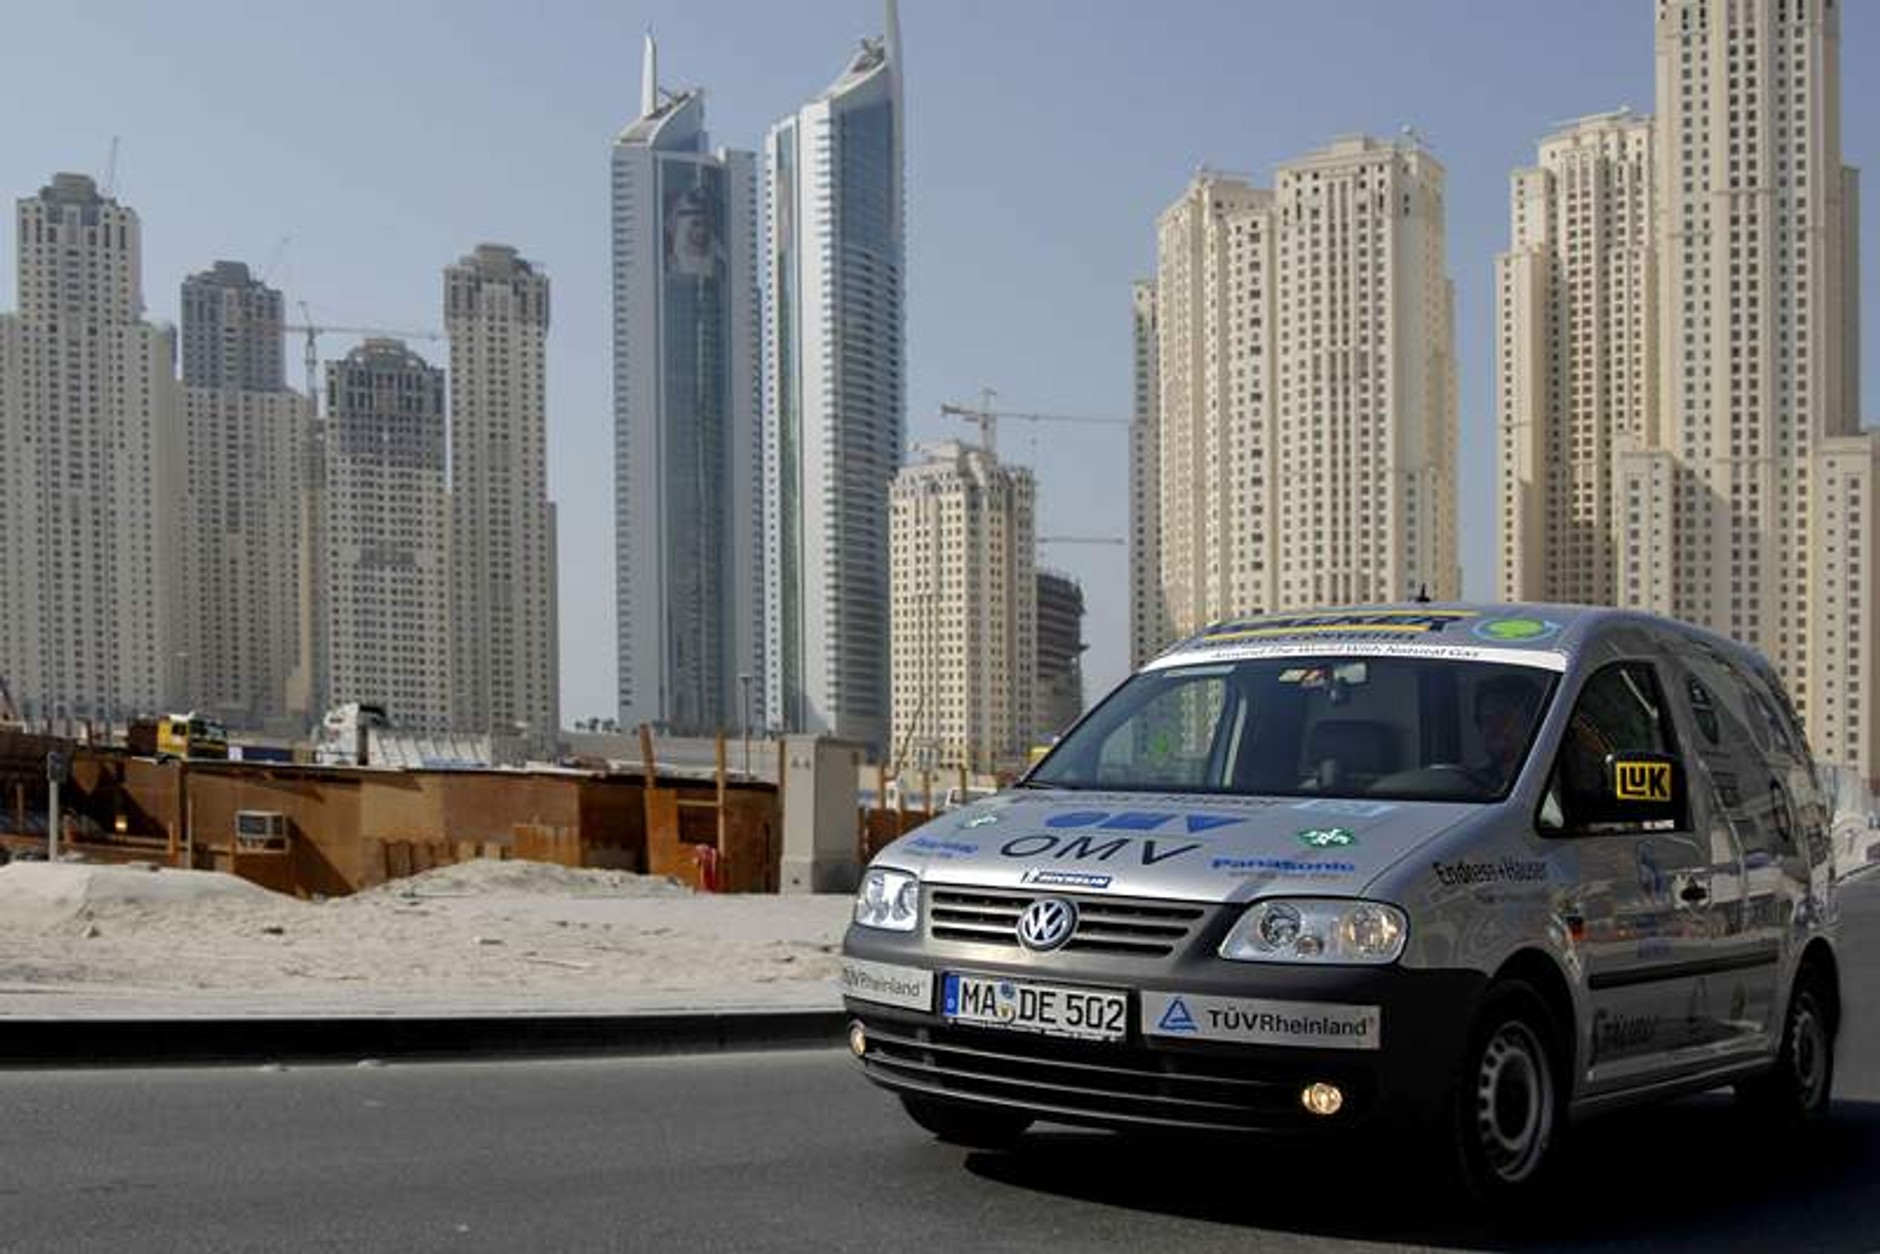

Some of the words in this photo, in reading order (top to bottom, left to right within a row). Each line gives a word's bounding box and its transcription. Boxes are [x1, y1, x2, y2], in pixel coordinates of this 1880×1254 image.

[1000, 834, 1200, 866] OMV
[1212, 856, 1356, 873] Panasonic
[961, 982, 998, 1016] MA
[1019, 988, 1057, 1025] DE
[1066, 995, 1125, 1033] 502
